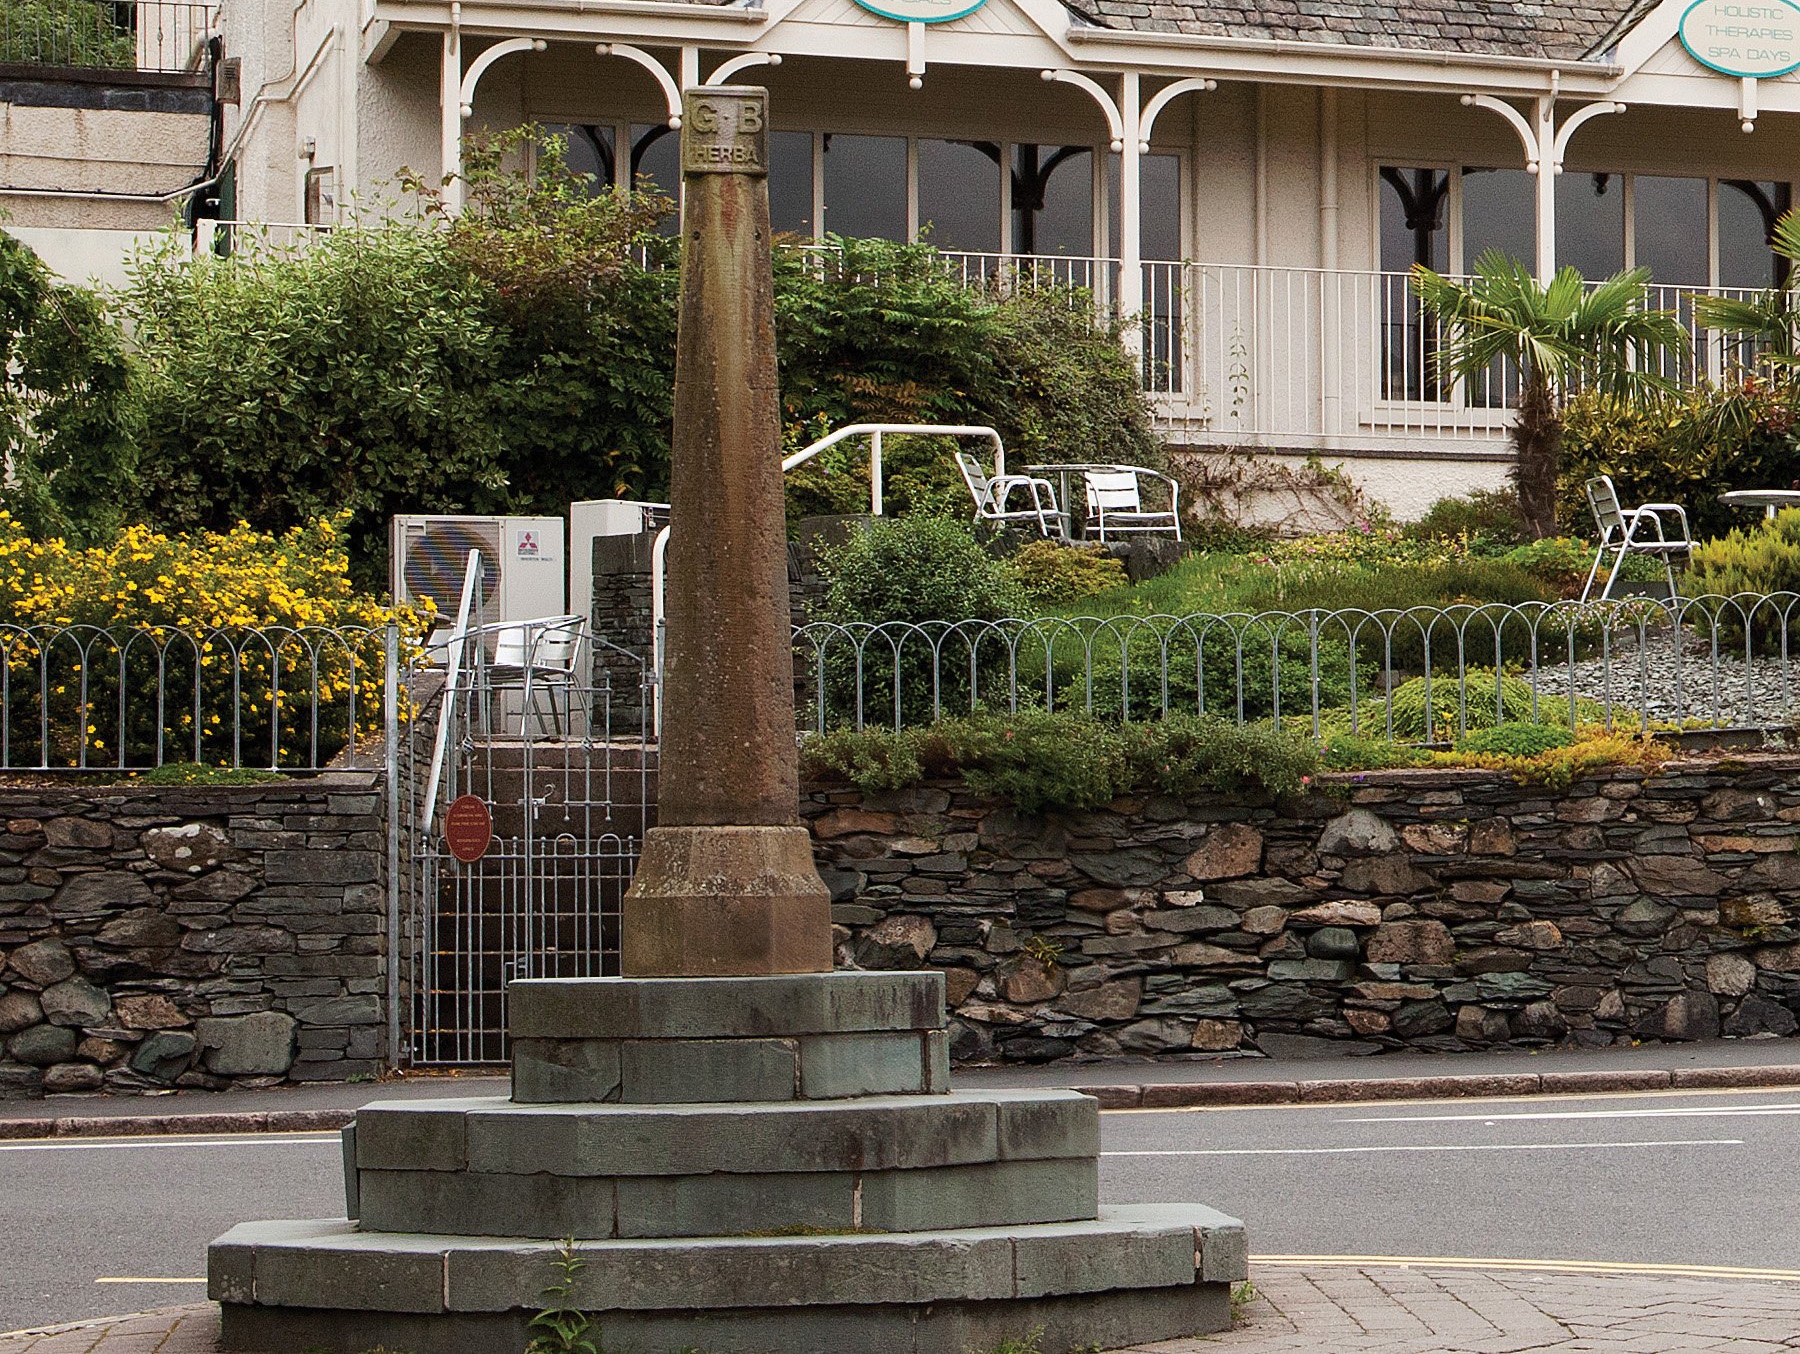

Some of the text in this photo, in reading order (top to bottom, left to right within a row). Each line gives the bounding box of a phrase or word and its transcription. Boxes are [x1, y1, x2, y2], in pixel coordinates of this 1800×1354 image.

[1714, 5, 1784, 20] HOLISTIC
[1705, 25, 1793, 41] THERAPIES
[1708, 47, 1791, 62] SPA DAYS
[691, 100, 763, 134] G B
[694, 145, 759, 164] HERBA
